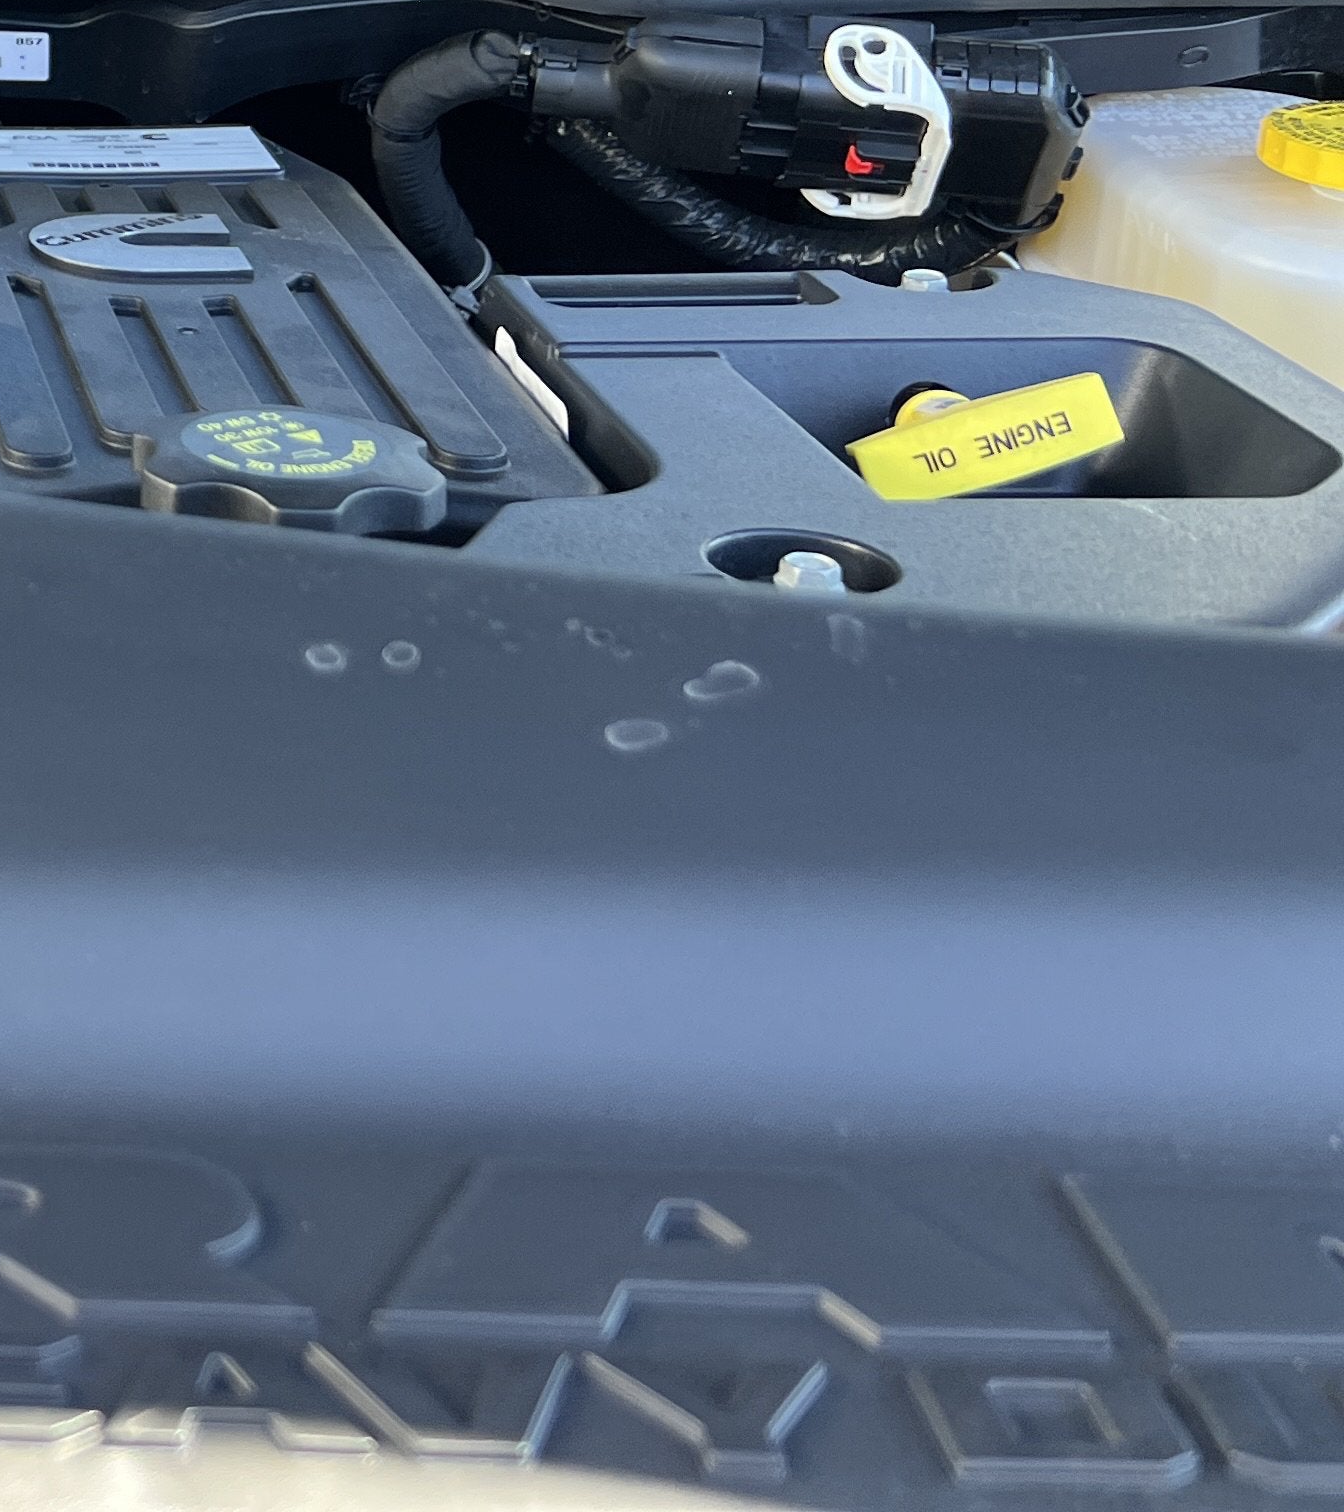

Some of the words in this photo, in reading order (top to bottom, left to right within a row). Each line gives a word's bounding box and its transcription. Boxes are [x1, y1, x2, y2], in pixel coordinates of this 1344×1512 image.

[15, 37, 44, 46] 857
[35, 214, 203, 246] Cummins
[973, 410, 1073, 459] ENGINE
[245, 457, 275, 473] OIL
[280, 459, 351, 473] ENGINE
[912, 446, 957, 474] OIL
